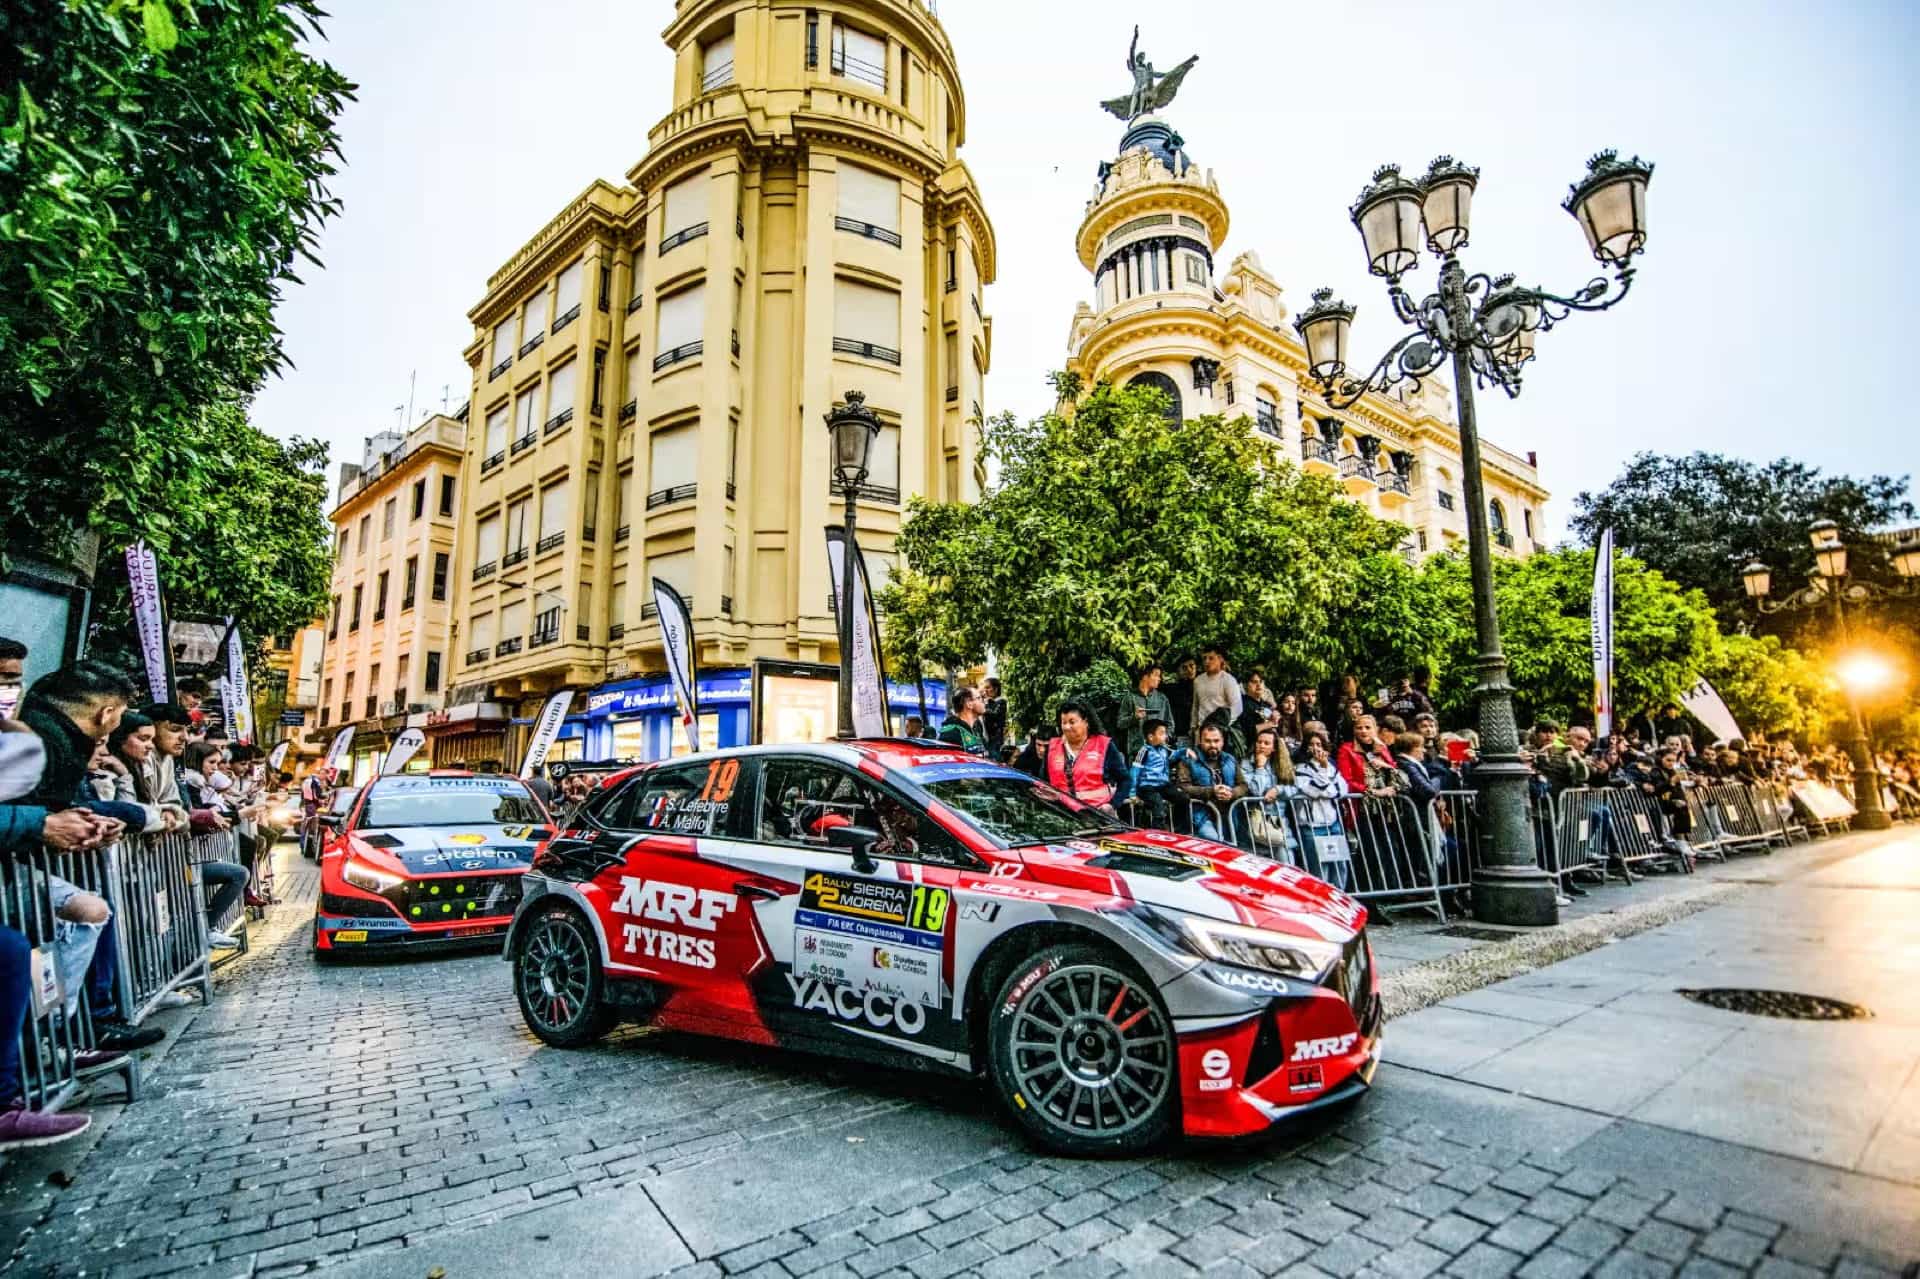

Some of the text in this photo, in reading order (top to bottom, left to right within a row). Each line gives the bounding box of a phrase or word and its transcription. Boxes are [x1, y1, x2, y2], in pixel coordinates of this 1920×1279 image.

[701, 759, 740, 802] 19
[667, 798, 729, 813] S. Lefebvre
[659, 814, 671, 828] A.
[424, 847, 517, 865] cetelem
[823, 878, 906, 902] RALLY SIERRA
[610, 875, 738, 932] MRF
[840, 894, 904, 915] MORENA
[913, 886, 948, 931] 19
[827, 918, 840, 929] FIA
[856, 922, 905, 941] Championship
[622, 923, 717, 969] TYRES
[1215, 969, 1289, 994] YACCO
[784, 971, 927, 1035] YACCO
[1290, 1032, 1359, 1062] MRF
